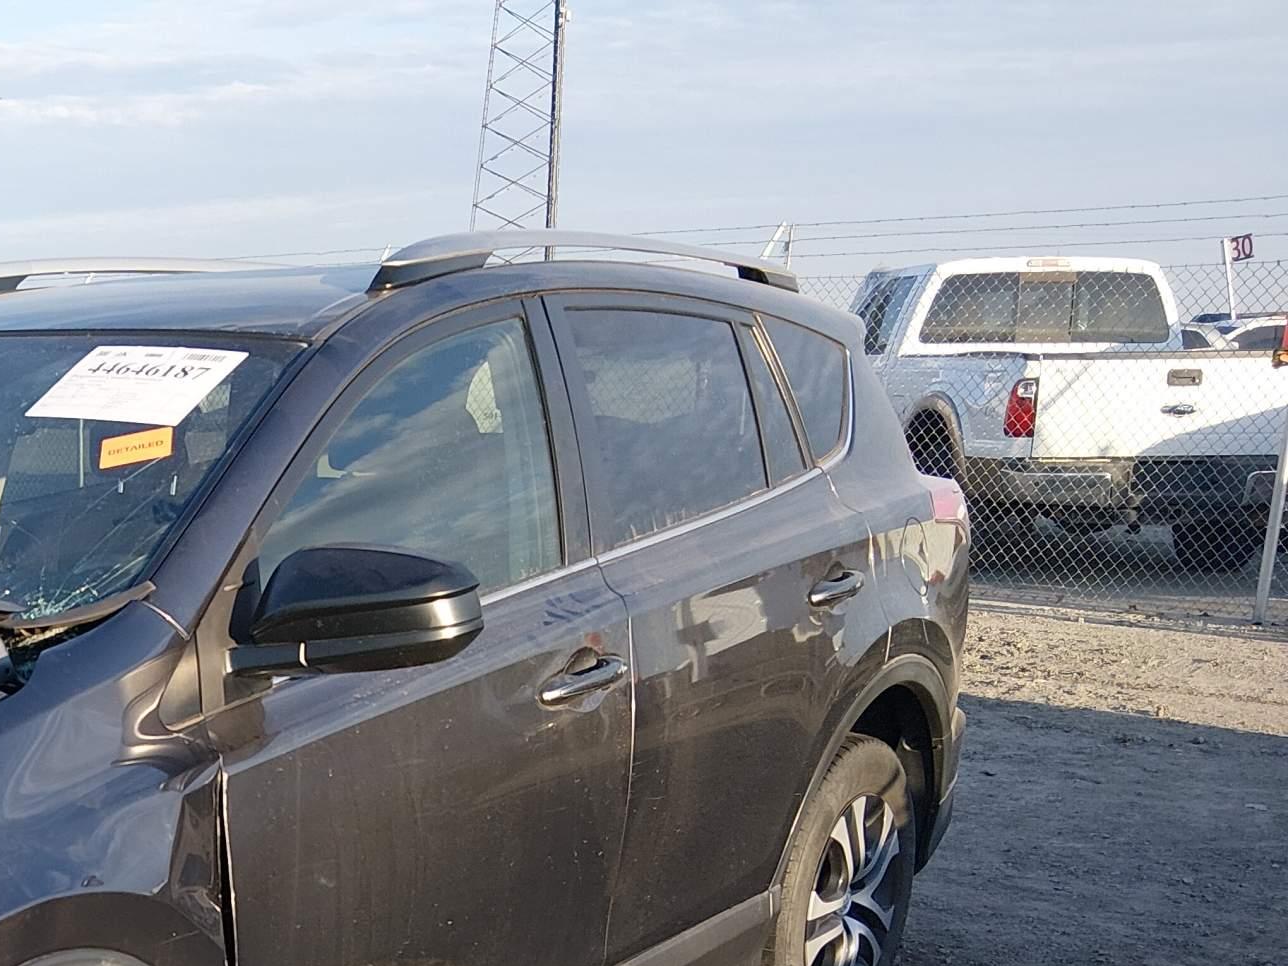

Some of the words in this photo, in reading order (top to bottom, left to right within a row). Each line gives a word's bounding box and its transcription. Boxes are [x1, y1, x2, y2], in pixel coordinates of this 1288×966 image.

[1230, 236, 1253, 261] 30
[88, 361, 211, 381] 44646187
[108, 440, 164, 456] DETAILED
